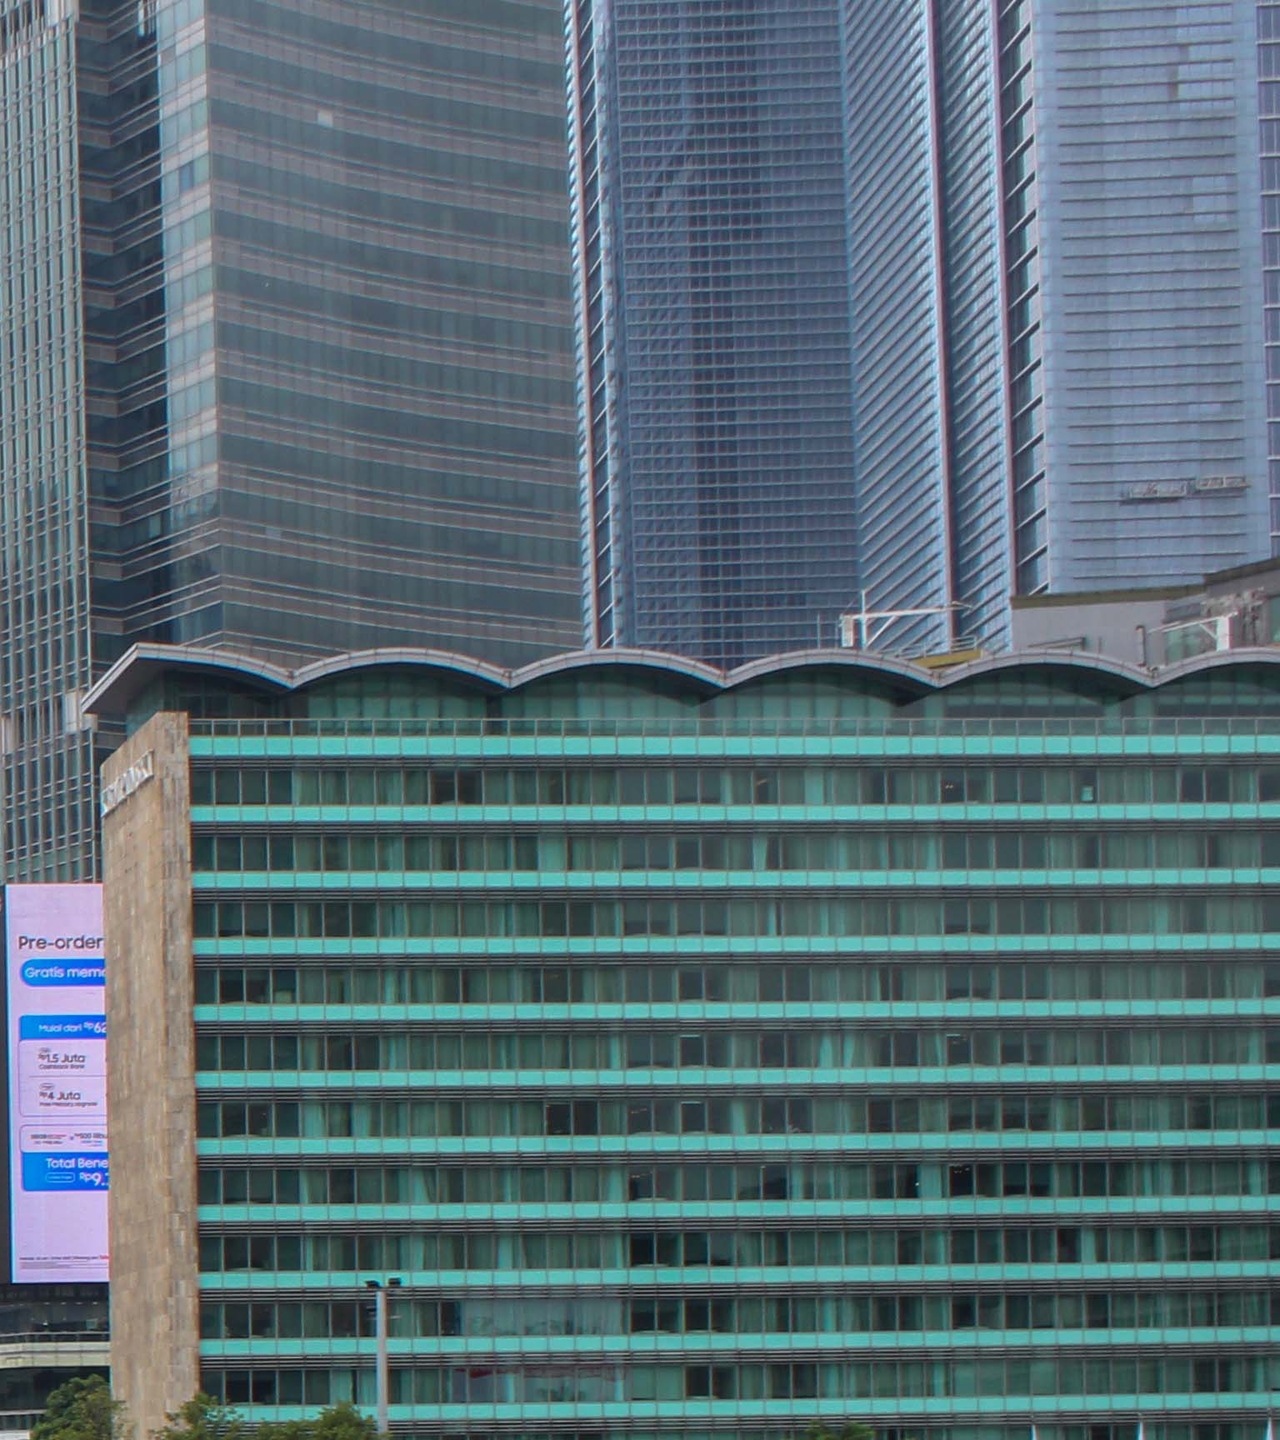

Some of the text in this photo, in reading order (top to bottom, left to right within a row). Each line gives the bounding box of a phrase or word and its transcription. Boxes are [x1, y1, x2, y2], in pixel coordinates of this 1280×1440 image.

[18, 935, 106, 950] Pre-order
[24, 966, 65, 978] Gratis
[61, 1053, 87, 1063] Juta
[57, 1091, 81, 1101] Juta
[46, 1158, 75, 1169] Total
